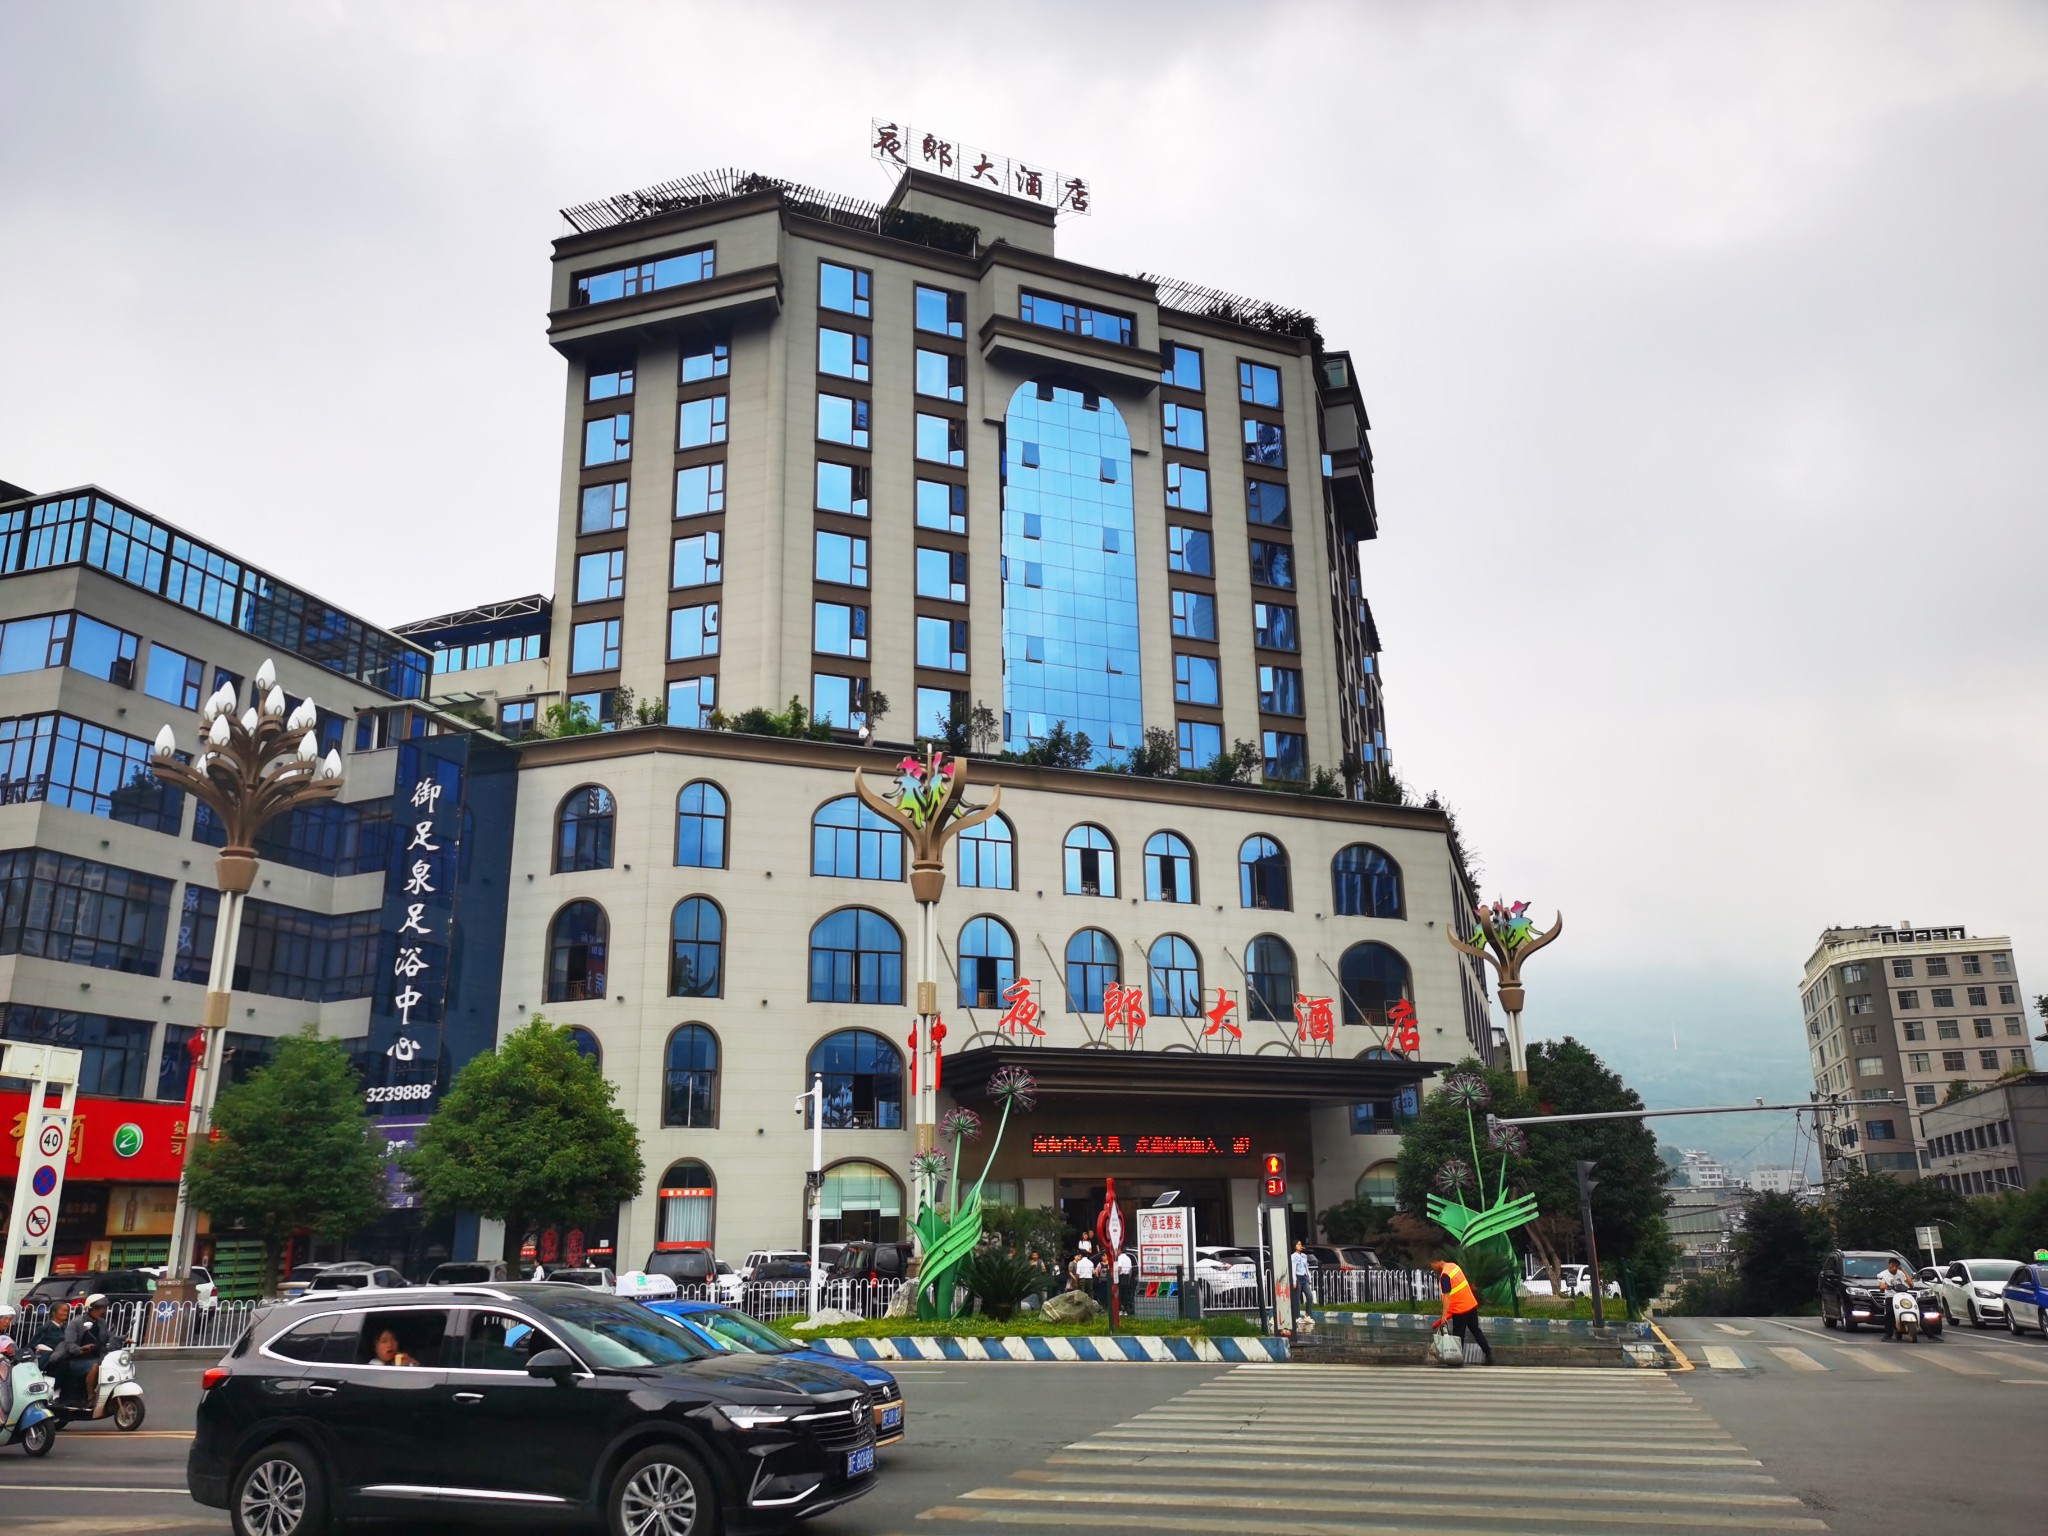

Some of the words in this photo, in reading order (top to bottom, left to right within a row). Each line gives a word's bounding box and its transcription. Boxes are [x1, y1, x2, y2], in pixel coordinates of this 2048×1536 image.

[873, 122, 1089, 211] 夜郎大酒店
[386, 777, 442, 1062] 御足泉足浴中心
[999, 977, 1421, 1054] 夜郎大酒店
[366, 1084, 432, 1102] 3239888
[44, 1133, 59, 1147] 40
[1268, 1180, 1284, 1193] 31
